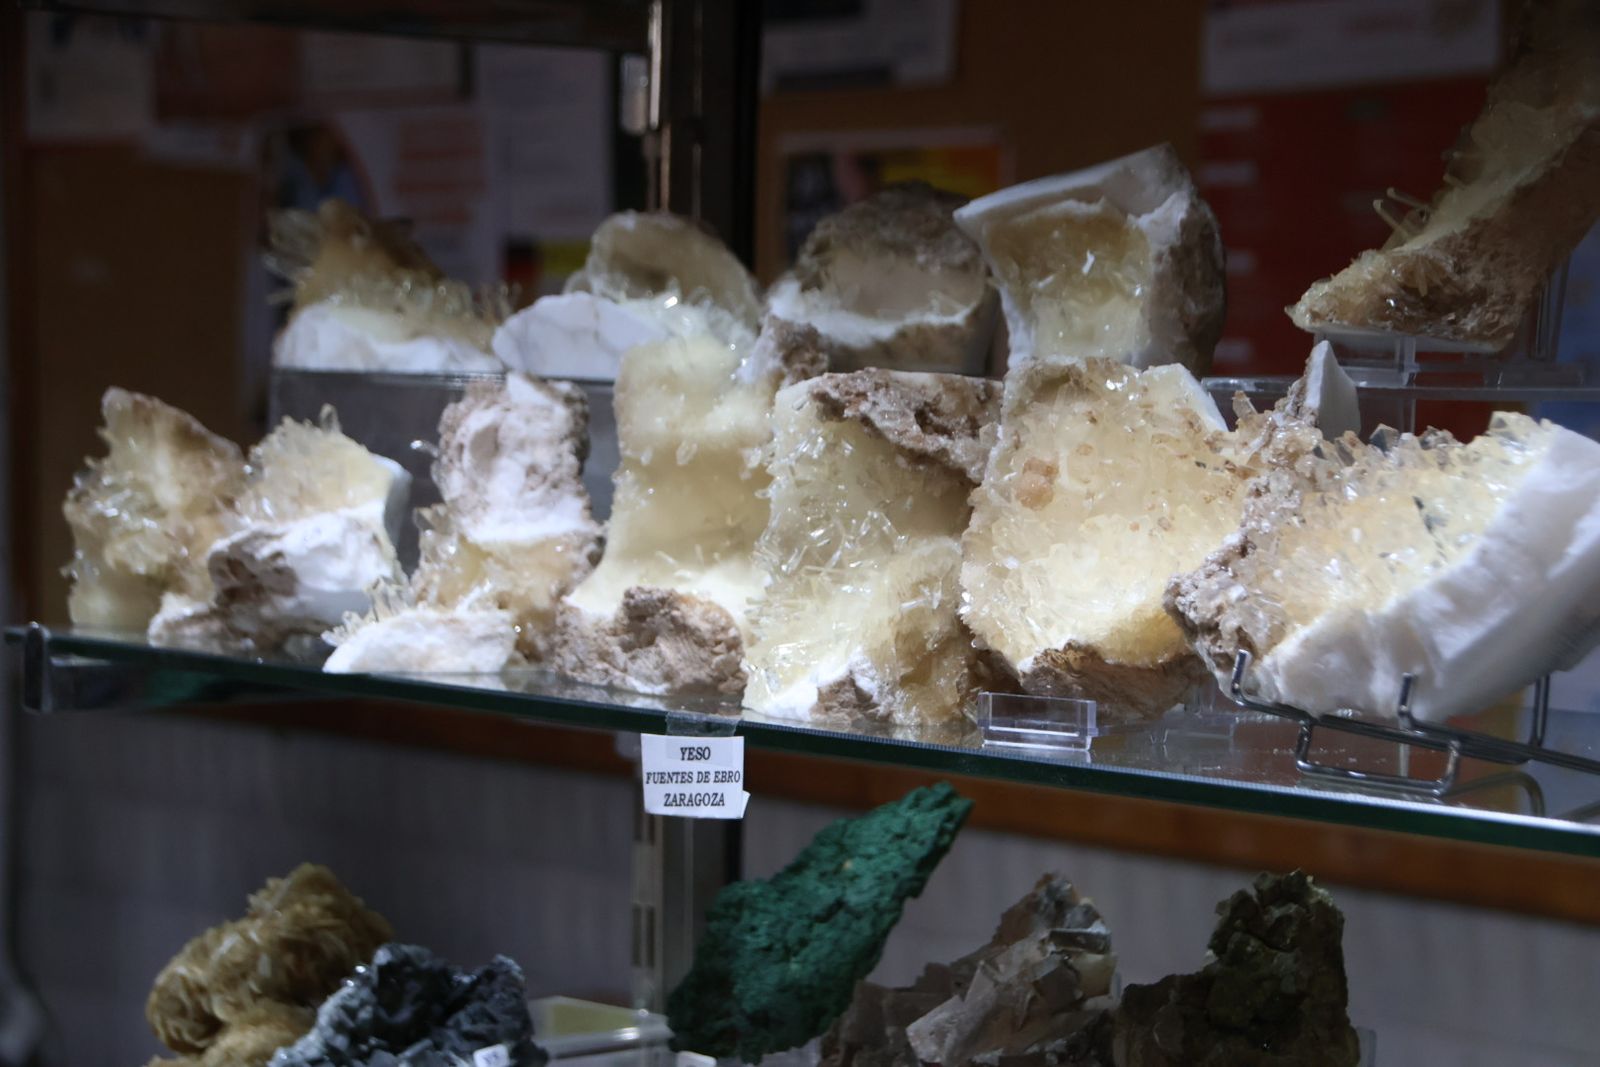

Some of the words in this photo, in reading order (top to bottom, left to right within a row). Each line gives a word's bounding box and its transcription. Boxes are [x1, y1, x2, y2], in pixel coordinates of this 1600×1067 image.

[680, 746, 711, 761] YESO
[646, 771, 693, 784] FUENTES
[696, 771, 710, 784] DE
[713, 770, 741, 783] EBRO
[664, 793, 725, 807] ZARAGOZA
